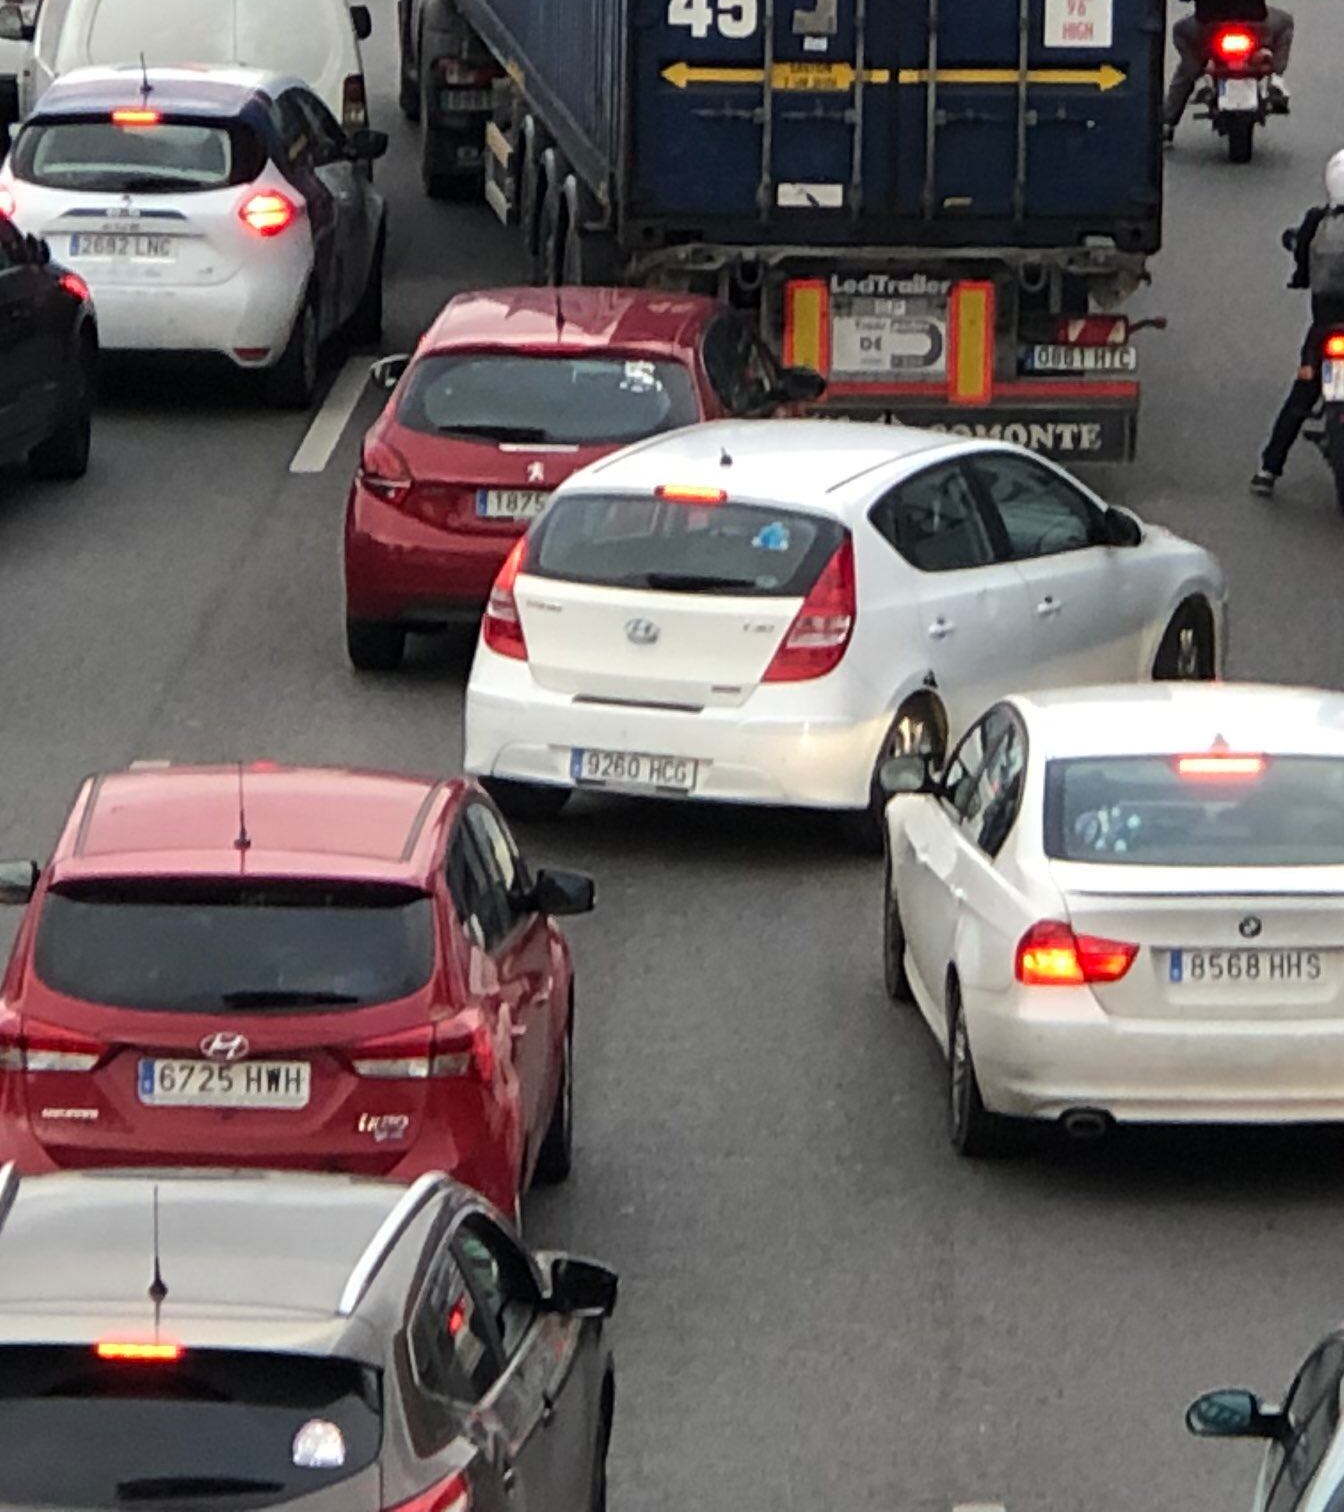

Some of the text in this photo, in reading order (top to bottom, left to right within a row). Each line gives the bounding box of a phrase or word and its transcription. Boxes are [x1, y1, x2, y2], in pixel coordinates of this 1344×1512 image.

[495, 490, 547, 512] 1875
[586, 752, 641, 780] 9260
[1189, 953, 1322, 980] 8568 HHS
[158, 1064, 304, 1095] 6725 HWH
